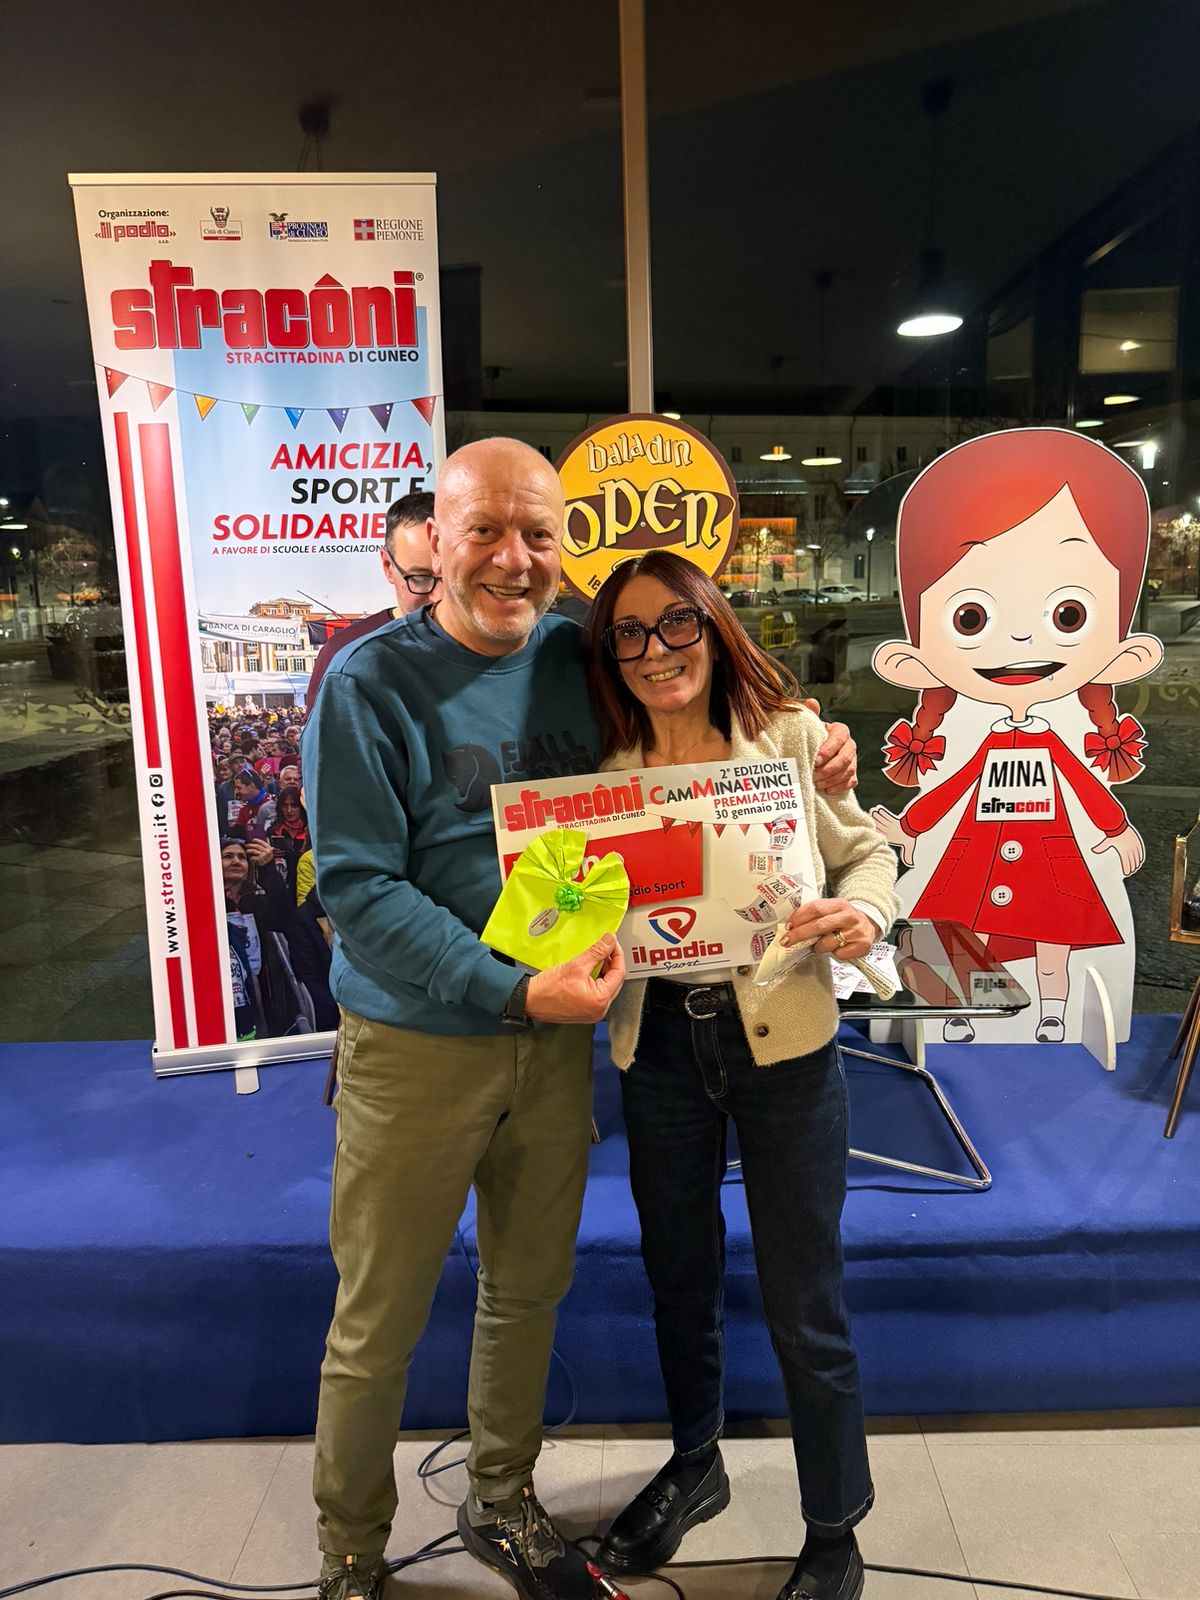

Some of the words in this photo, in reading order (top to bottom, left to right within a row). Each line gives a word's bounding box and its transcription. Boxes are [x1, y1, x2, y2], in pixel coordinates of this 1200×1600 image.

[98, 209, 170, 220] Organizzazione:
[376, 219, 423, 230] REGIONE
[376, 231, 424, 241] PIEMONTE
[226, 351, 345, 364] STRACITTADINA
[349, 351, 364, 363] DI
[367, 350, 419, 363] CUNEO
[270, 442, 433, 474] AMICIZIA,
[585, 433, 693, 473] baladin
[291, 477, 400, 505] SPORT
[212, 513, 386, 541] SOLIDARIE
[212, 547, 219, 555] A
[221, 546, 258, 555] FAVORE
[260, 546, 270, 554] DI
[272, 545, 310, 554] SCUOLE
[311, 545, 317, 554] E
[318, 544, 386, 554] ASSOCIAZION
[208, 622, 239, 631] BANCA
[241, 624, 250, 632] DI
[252, 625, 296, 635] CARAGLIO
[734, 761, 789, 777] EDIZIONE
[988, 760, 1047, 788] MINA
[713, 789, 796, 809] PREMIAZIONE
[715, 808, 728, 820] 30
[731, 803, 772, 820] gennaio
[775, 799, 798, 811] 2026
[557, 817, 612, 829] STRACITTADINA
[612, 814, 620, 822] DI
[620, 810, 646, 820] CUNEO
[153, 813, 179, 953] www.straconi.it
[629, 885, 652, 897] odio
[653, 879, 686, 895] Sport
[769, 879, 790, 896] 7625
[662, 959, 701, 971] Sport
